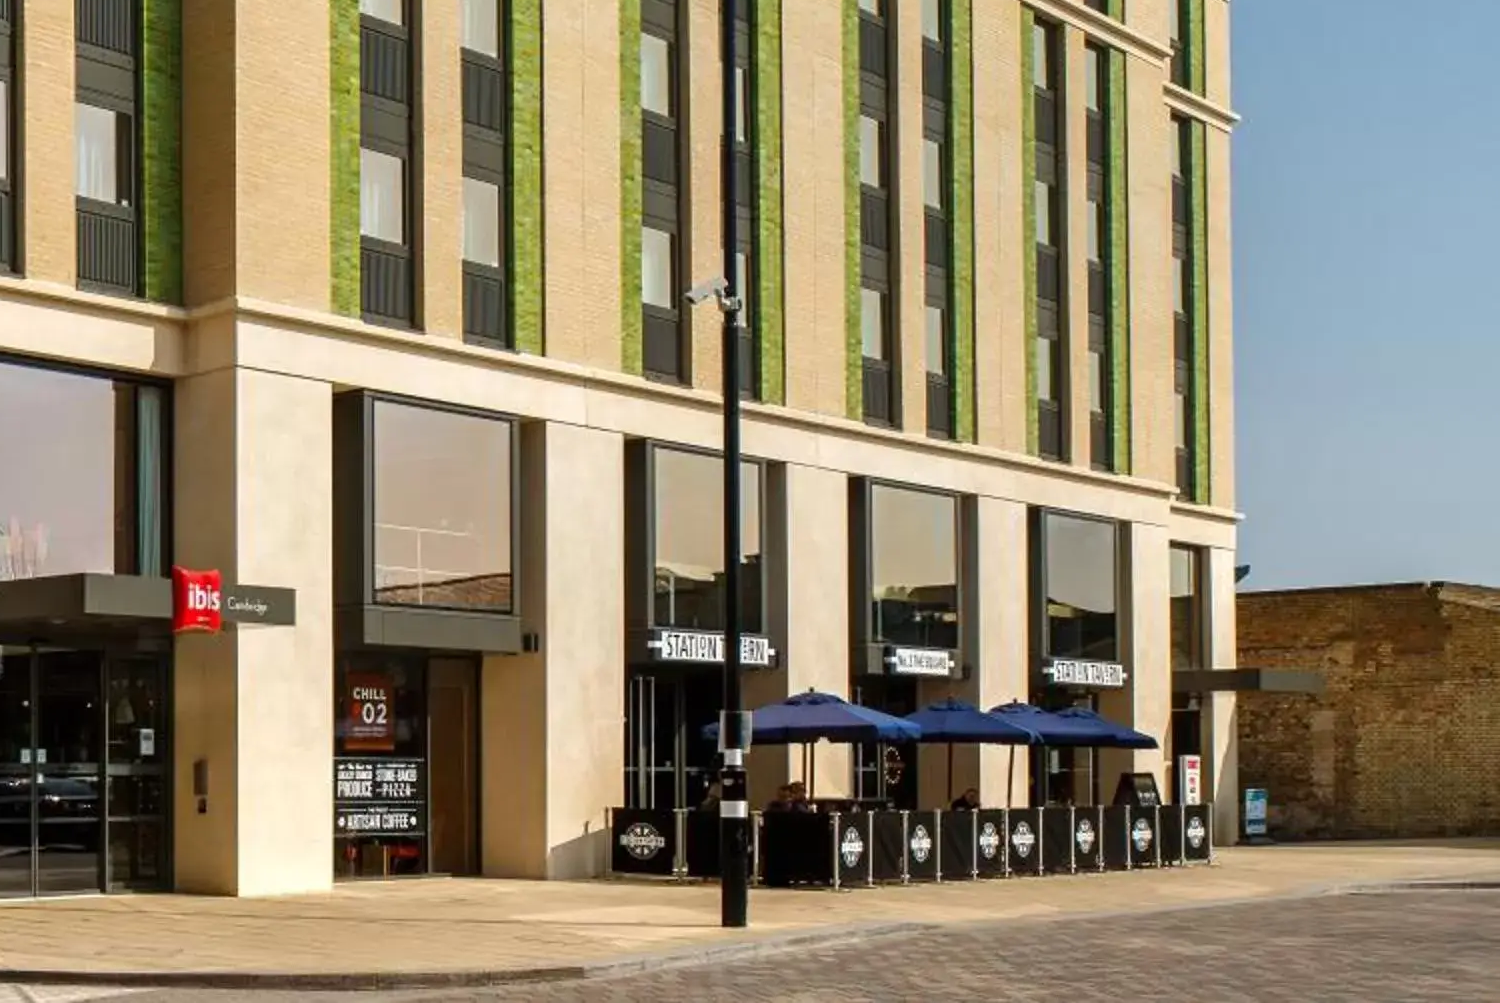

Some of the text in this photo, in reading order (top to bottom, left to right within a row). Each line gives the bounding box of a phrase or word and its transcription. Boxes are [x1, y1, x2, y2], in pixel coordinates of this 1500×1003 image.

[188, 582, 221, 612] ibis
[353, 687, 387, 700] CHILL
[362, 702, 387, 724] 02
[382, 812, 408, 829] COFFEE
